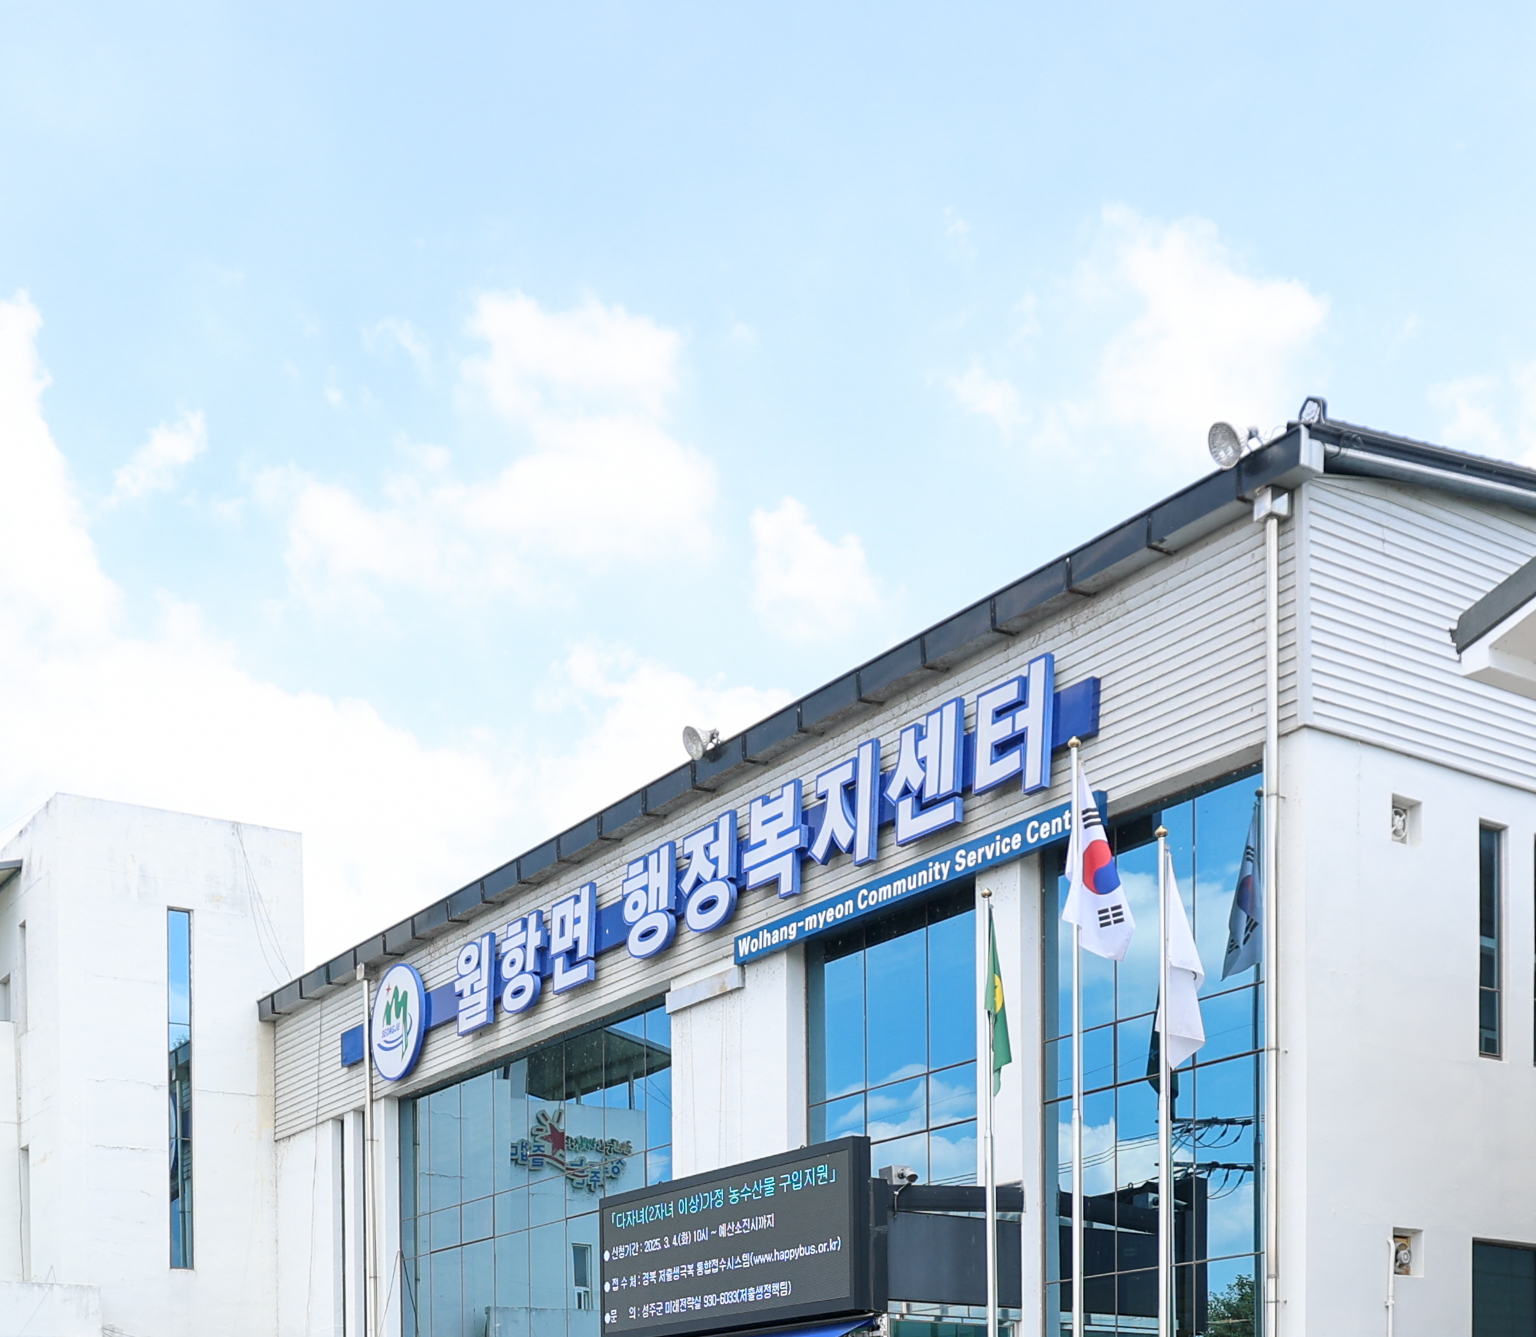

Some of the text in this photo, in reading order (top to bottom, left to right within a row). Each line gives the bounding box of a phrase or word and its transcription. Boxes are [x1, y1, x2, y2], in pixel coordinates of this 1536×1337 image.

[455, 653, 1055, 1036] 월항면 행정복지센터
[737, 809, 1073, 957] Wolhang-myeon Community Service Cent
[728, 1176, 776, 1205] 농수산물
[642, 1301, 663, 1319] 성주군
